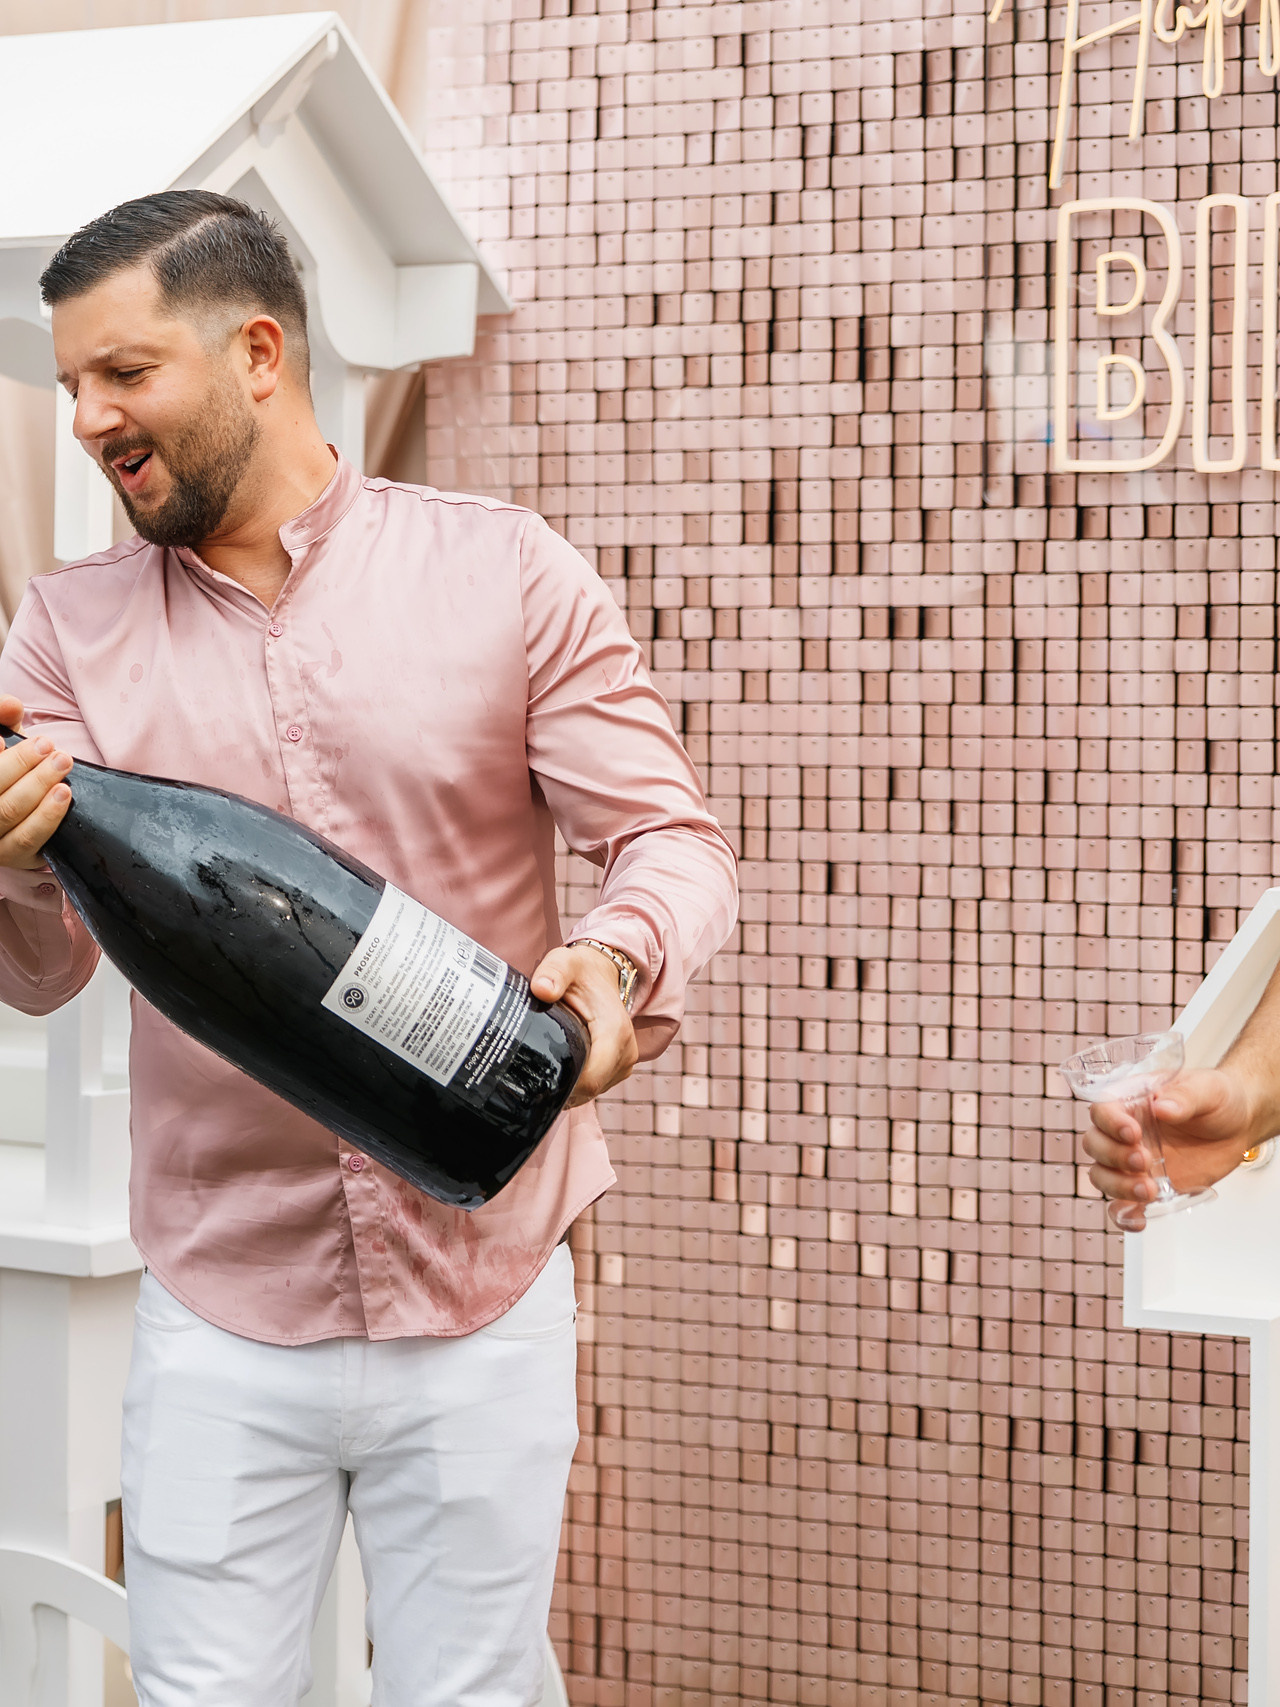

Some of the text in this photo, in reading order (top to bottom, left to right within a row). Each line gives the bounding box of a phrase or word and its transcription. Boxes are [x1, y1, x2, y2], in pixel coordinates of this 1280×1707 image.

[1053, 193, 1280, 474] BI
[354, 937, 381, 977] PROSECCO
[367, 967, 381, 986] ITALIAN
[373, 976, 384, 990] BRUT
[345, 988, 363, 1008] 90
